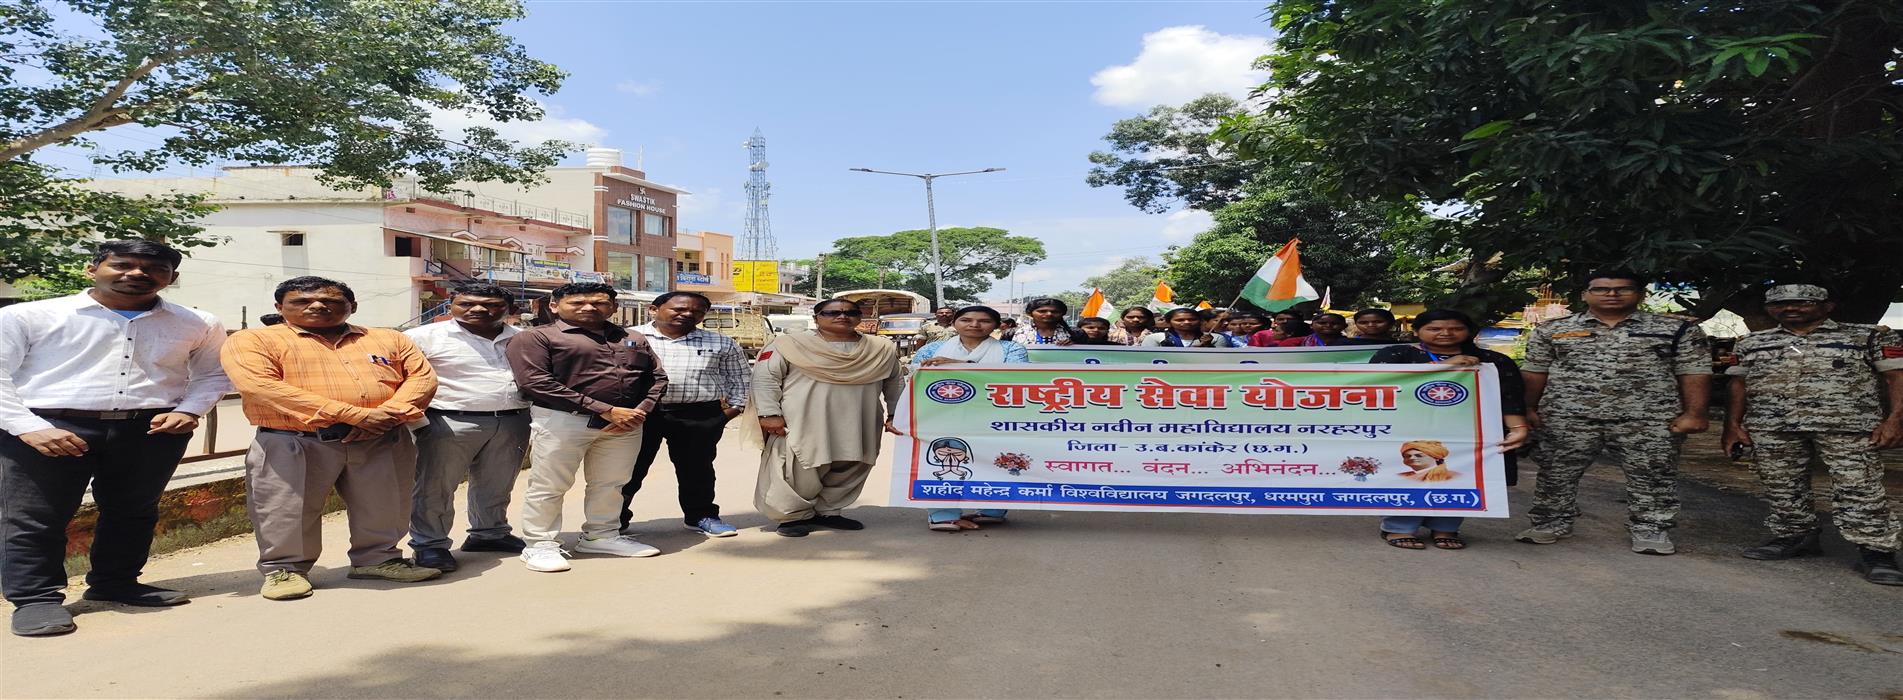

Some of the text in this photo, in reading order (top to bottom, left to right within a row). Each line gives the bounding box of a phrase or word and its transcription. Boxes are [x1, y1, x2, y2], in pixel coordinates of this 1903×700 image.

[617, 199, 666, 214] FASHION HOUSE
[630, 193, 656, 205] SWASTIK
[988, 377, 1125, 411] राष्ट्रीय
[1137, 377, 1229, 408] सेवा
[1242, 378, 1400, 408] योजना
[990, 418, 1393, 439] शासकीय नवीन महाविद्यालय नरहरपुर
[1243, 442, 1309, 454] (छ.ग.)
[922, 481, 1480, 507] शहीद महेन्द्र कर्मा विश्वविद्यालय जगदलपुर, धरमपुरा जगदलपुर, (छ.ग.)
